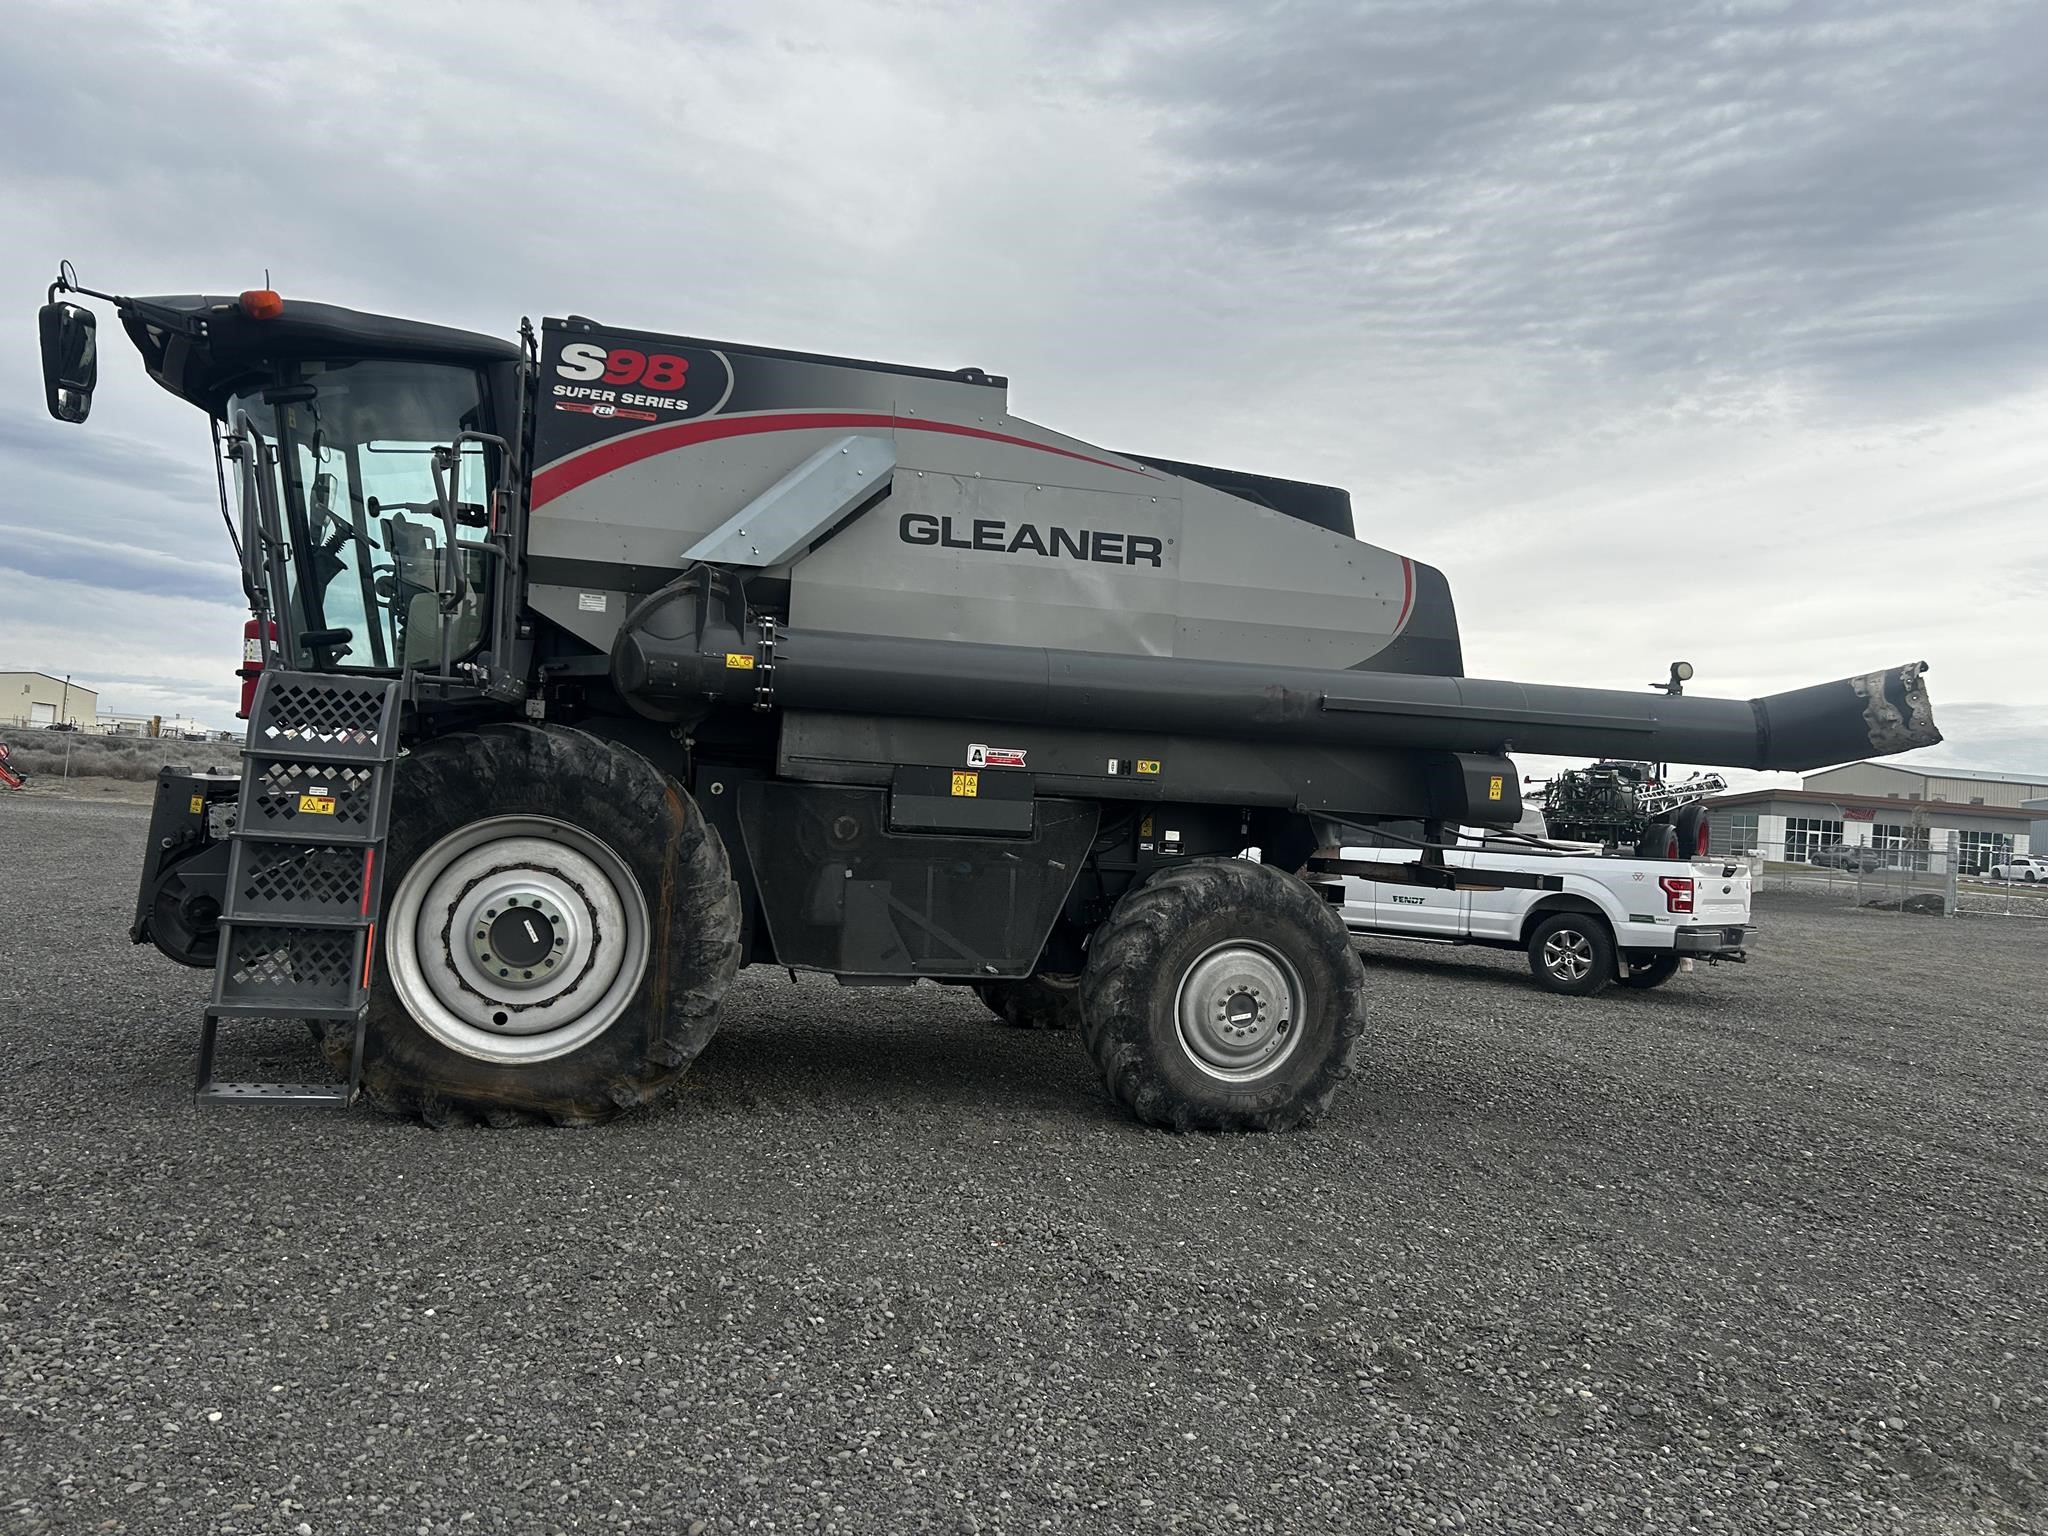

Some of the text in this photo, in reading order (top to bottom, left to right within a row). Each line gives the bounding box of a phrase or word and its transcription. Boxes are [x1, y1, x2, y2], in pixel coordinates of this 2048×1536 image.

[556, 343, 690, 391] S98
[552, 384, 689, 411] SUPER SERIES
[899, 513, 1163, 568] GLEANER
[1392, 895, 1426, 905] FENDT
